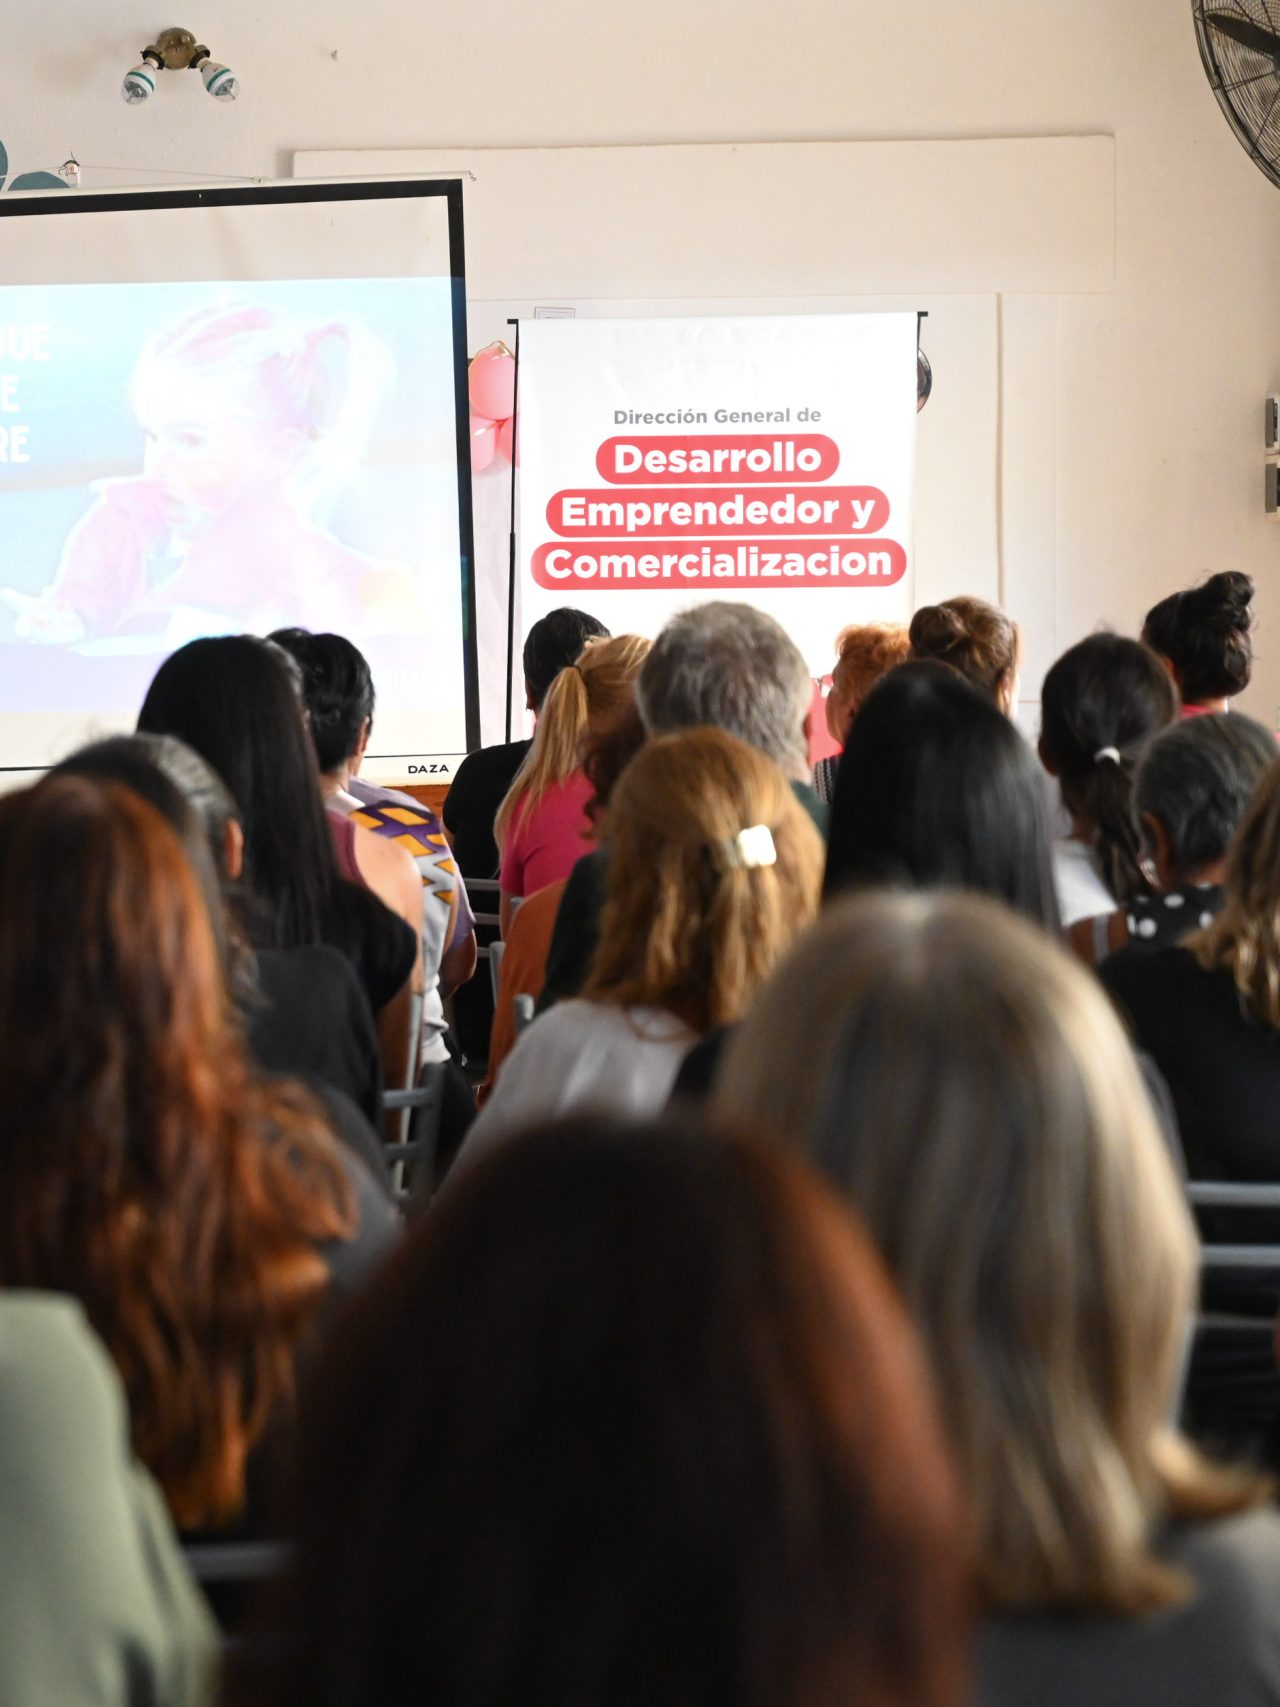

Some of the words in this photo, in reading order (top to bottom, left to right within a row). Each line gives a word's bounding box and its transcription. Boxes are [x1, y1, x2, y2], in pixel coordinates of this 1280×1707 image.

[613, 409, 708, 426] Dirección
[713, 408, 790, 424] General
[796, 407, 822, 423] de
[614, 441, 822, 474] Desarrollo
[561, 493, 839, 532] Emprendedor
[851, 498, 875, 529] y
[544, 546, 892, 580] Comercializacion
[408, 764, 449, 774] DAZA
